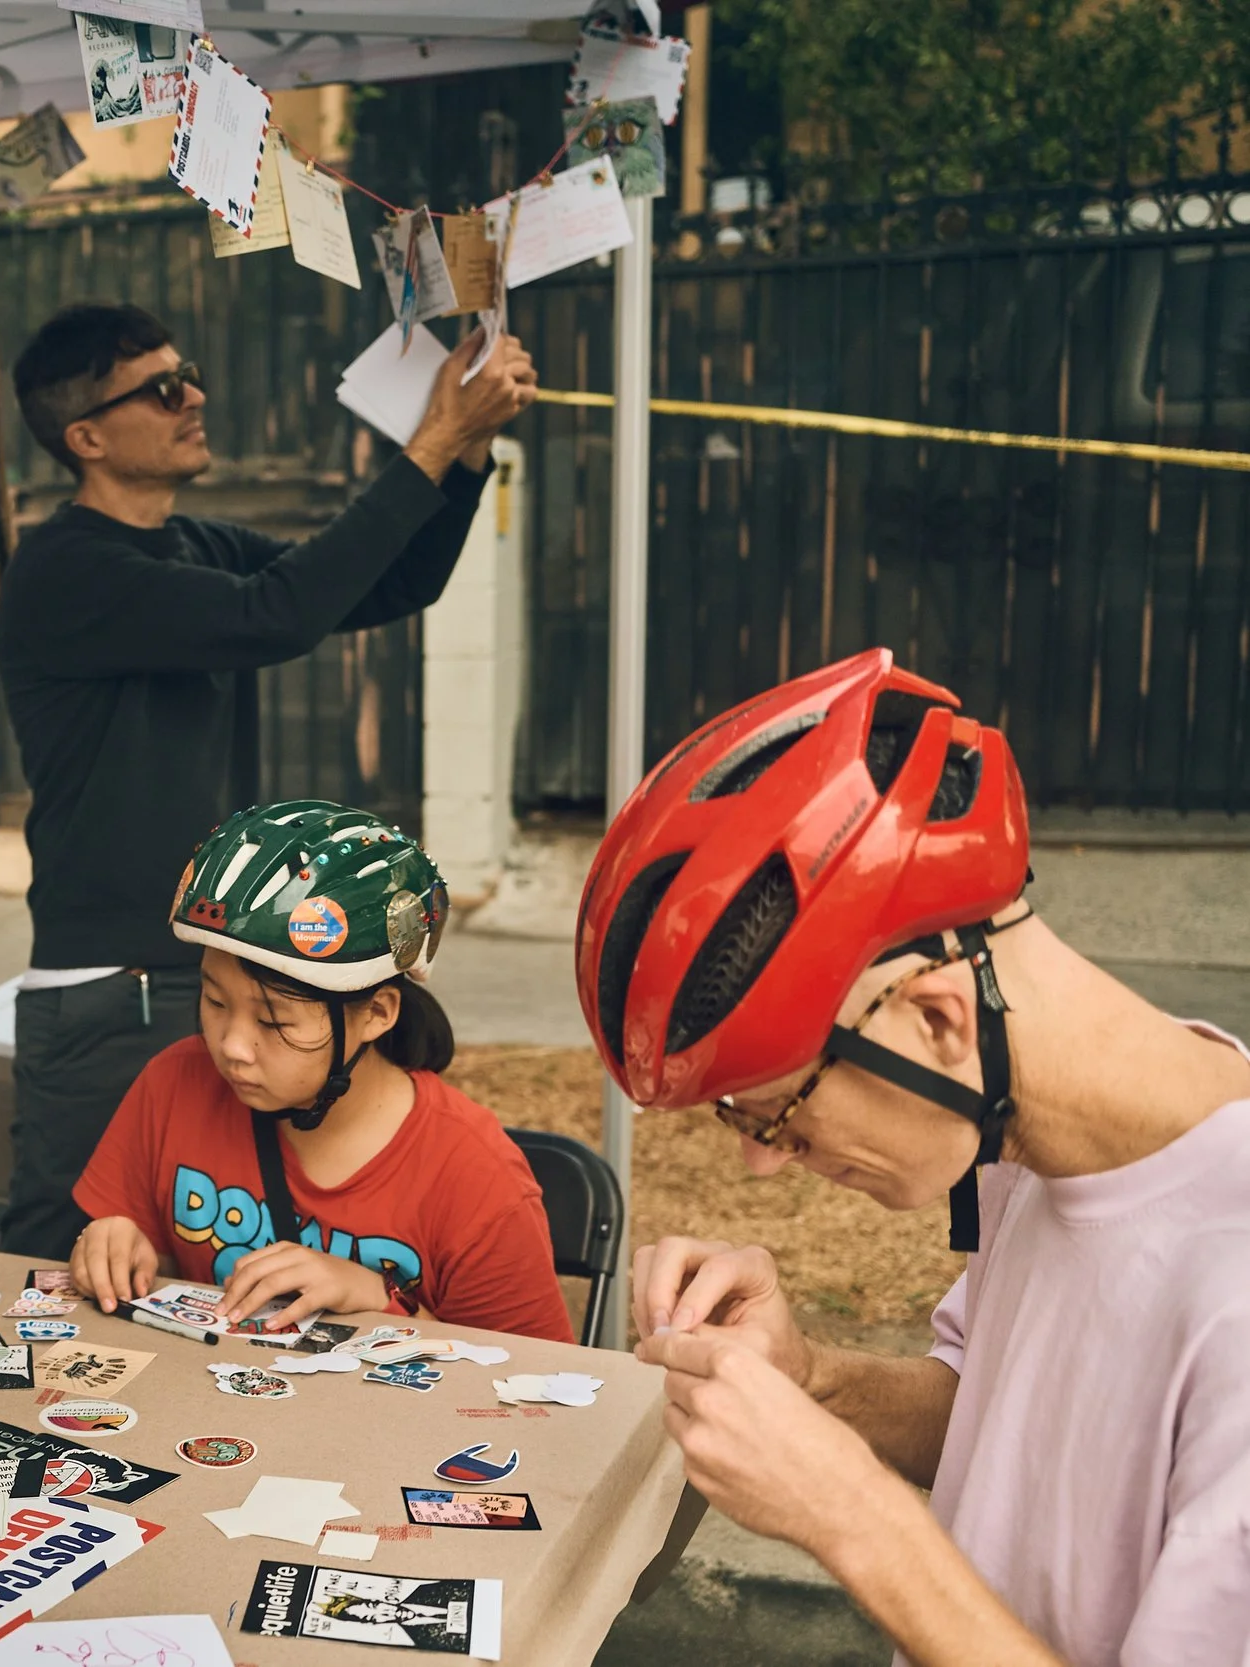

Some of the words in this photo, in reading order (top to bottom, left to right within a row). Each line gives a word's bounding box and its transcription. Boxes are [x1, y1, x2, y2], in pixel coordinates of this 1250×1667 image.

[175, 132, 191, 177] POSTCARDS
[186, 80, 200, 126] DEMOCRACY
[808, 797, 869, 882] BONTRAGER
[294, 922, 299, 932] I
[300, 924, 312, 933] am
[313, 923, 328, 933] the
[294, 932, 339, 944] Movement.
[191, 1289, 219, 1301] ENTER
[44, 1442, 65, 1453] IN
